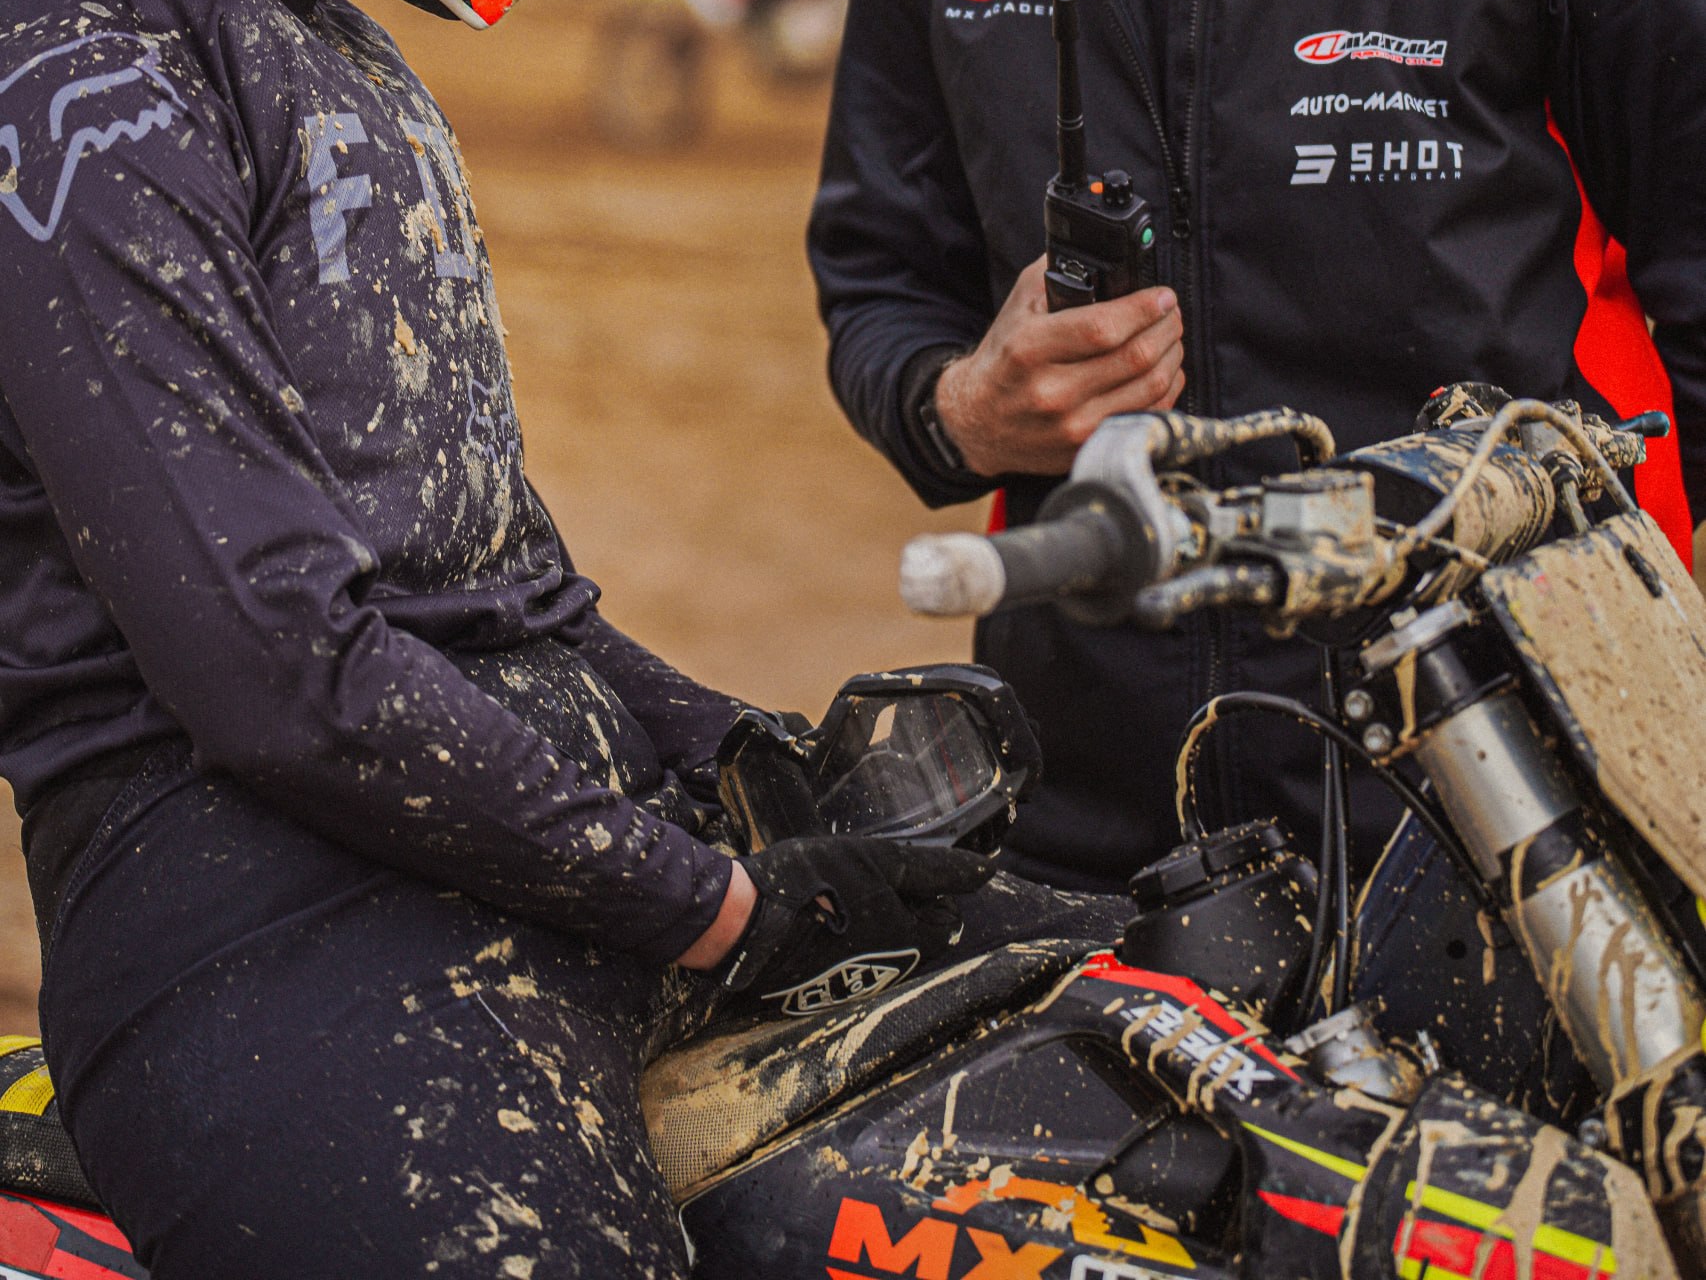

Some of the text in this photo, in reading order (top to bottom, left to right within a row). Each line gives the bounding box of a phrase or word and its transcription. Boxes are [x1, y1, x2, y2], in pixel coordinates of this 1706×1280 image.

[945, 1, 1053, 20] MX ACADE
[1290, 91, 1449, 118] AUTO-MARKET
[1350, 140, 1463, 172] SHOT
